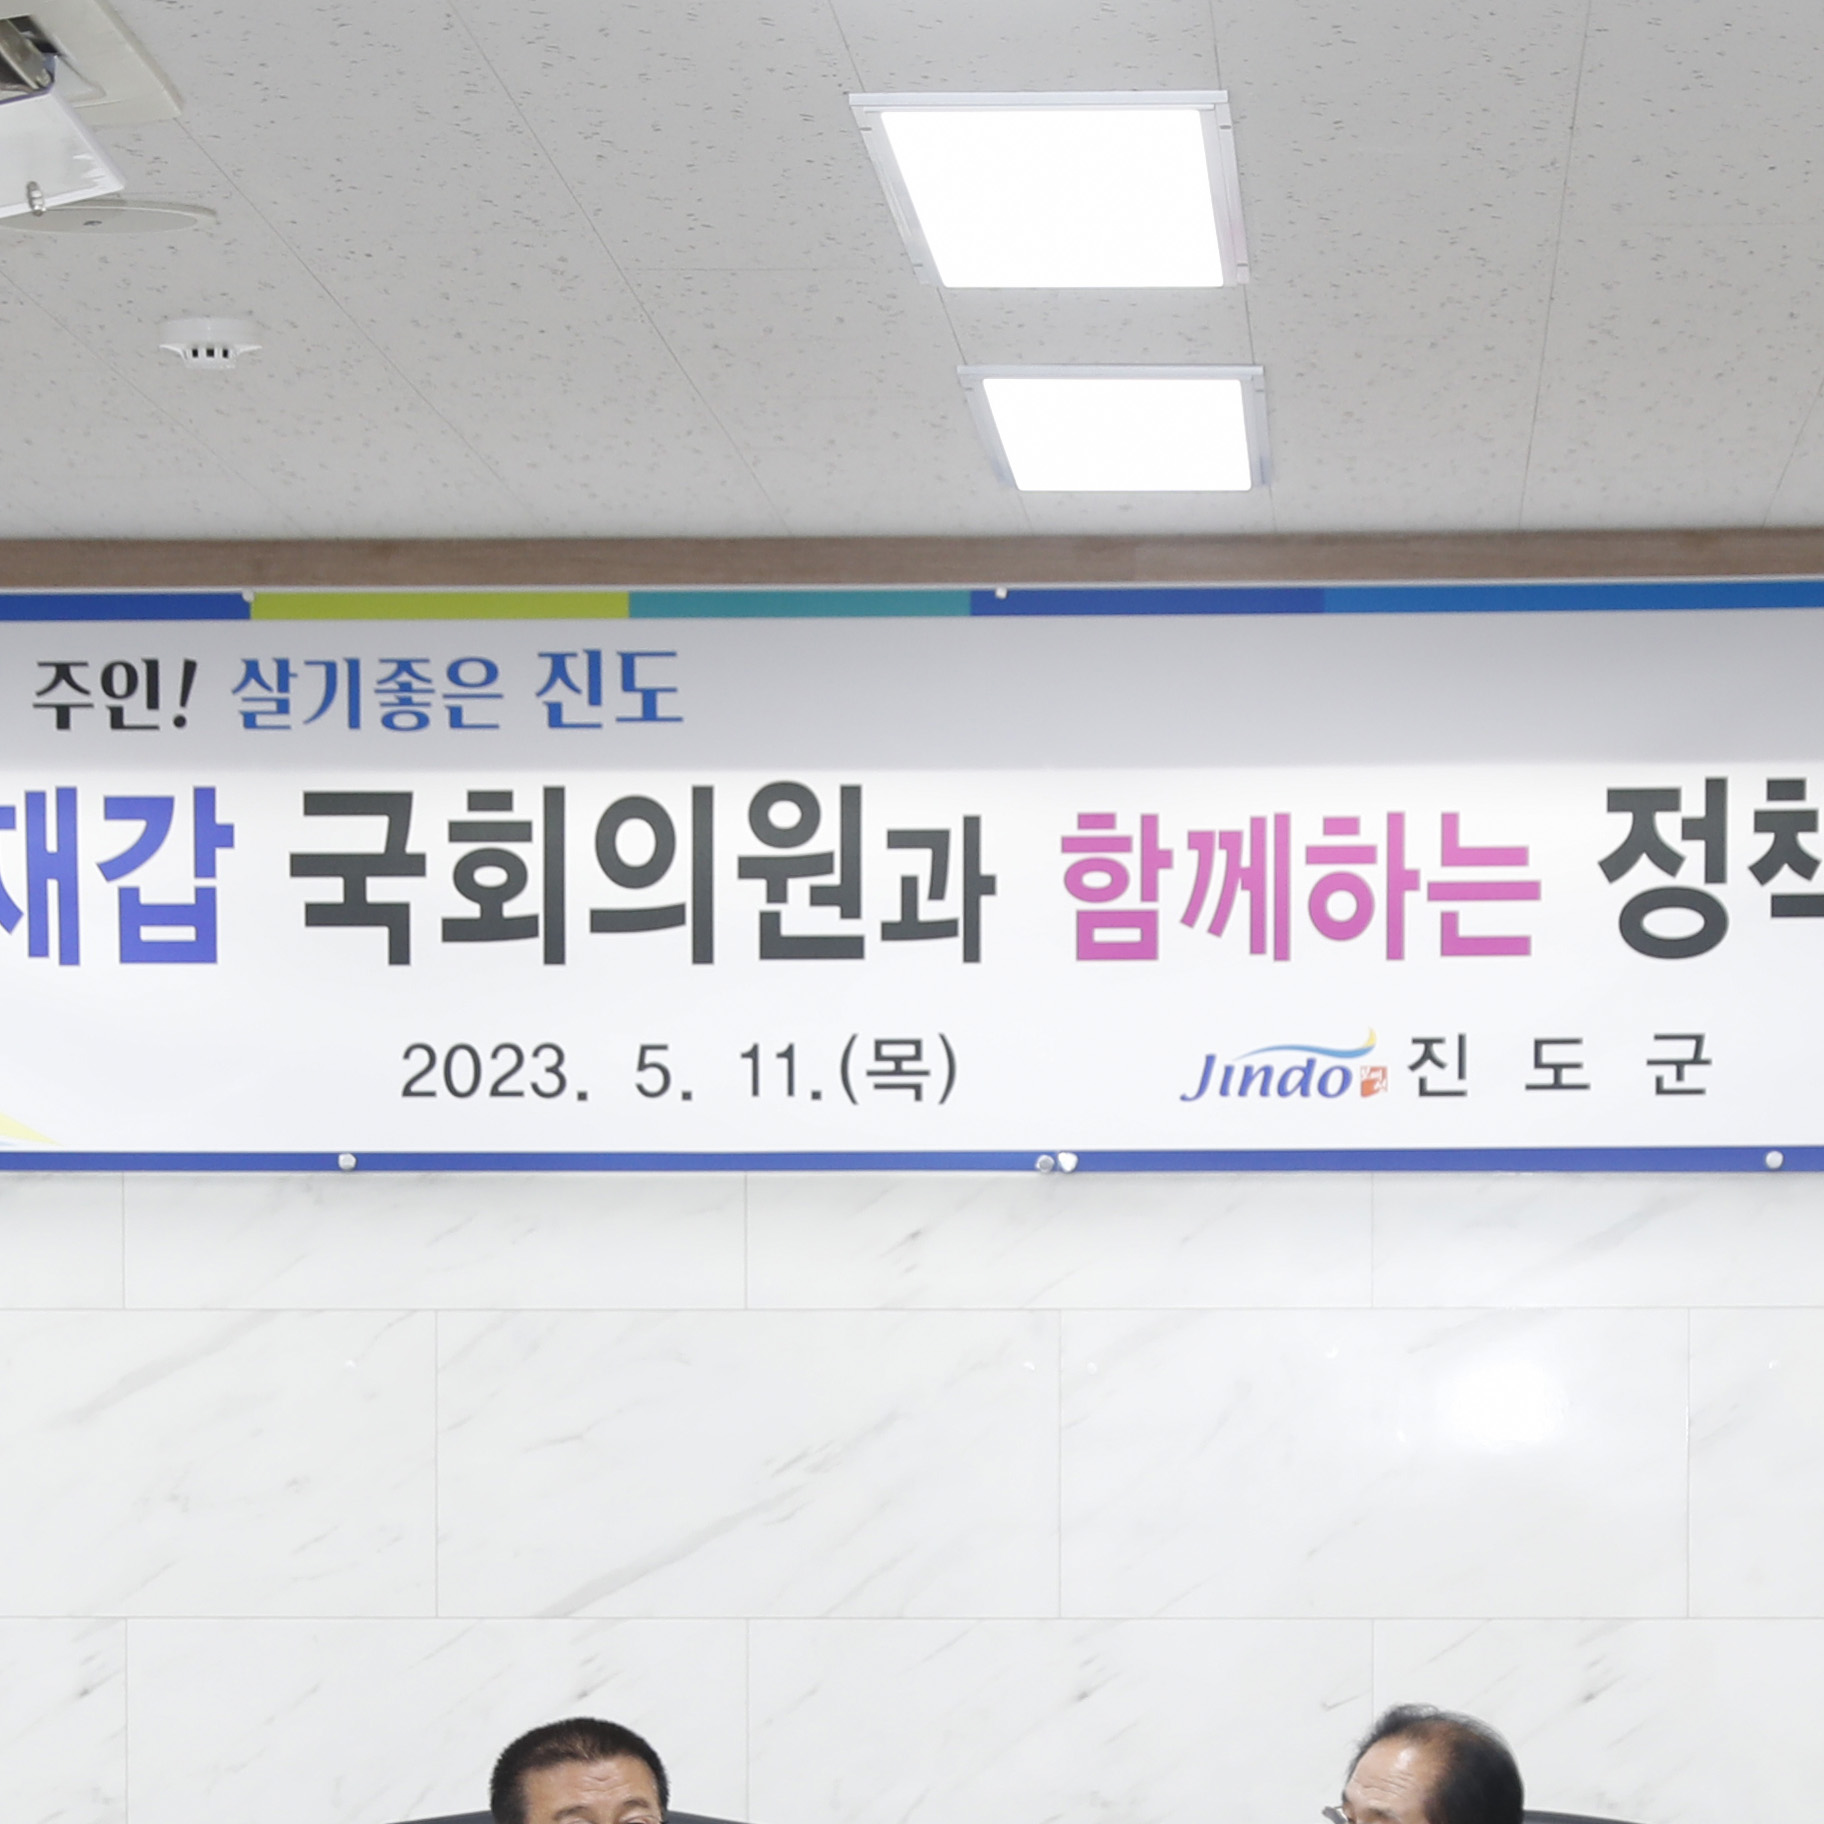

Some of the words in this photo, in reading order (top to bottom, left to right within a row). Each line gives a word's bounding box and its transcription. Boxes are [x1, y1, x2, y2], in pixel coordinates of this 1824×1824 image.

[32, 657, 198, 732] 주인!
[231, 656, 505, 733] 살기좋은
[535, 647, 685, 730] 진도
[289, 776, 997, 967] 국회의원과
[1060, 811, 1542, 962] 함께하는
[401, 1041, 588, 1102] 2023.
[635, 1043, 693, 1102] 5.
[1179, 1052, 1353, 1102] Jindo
